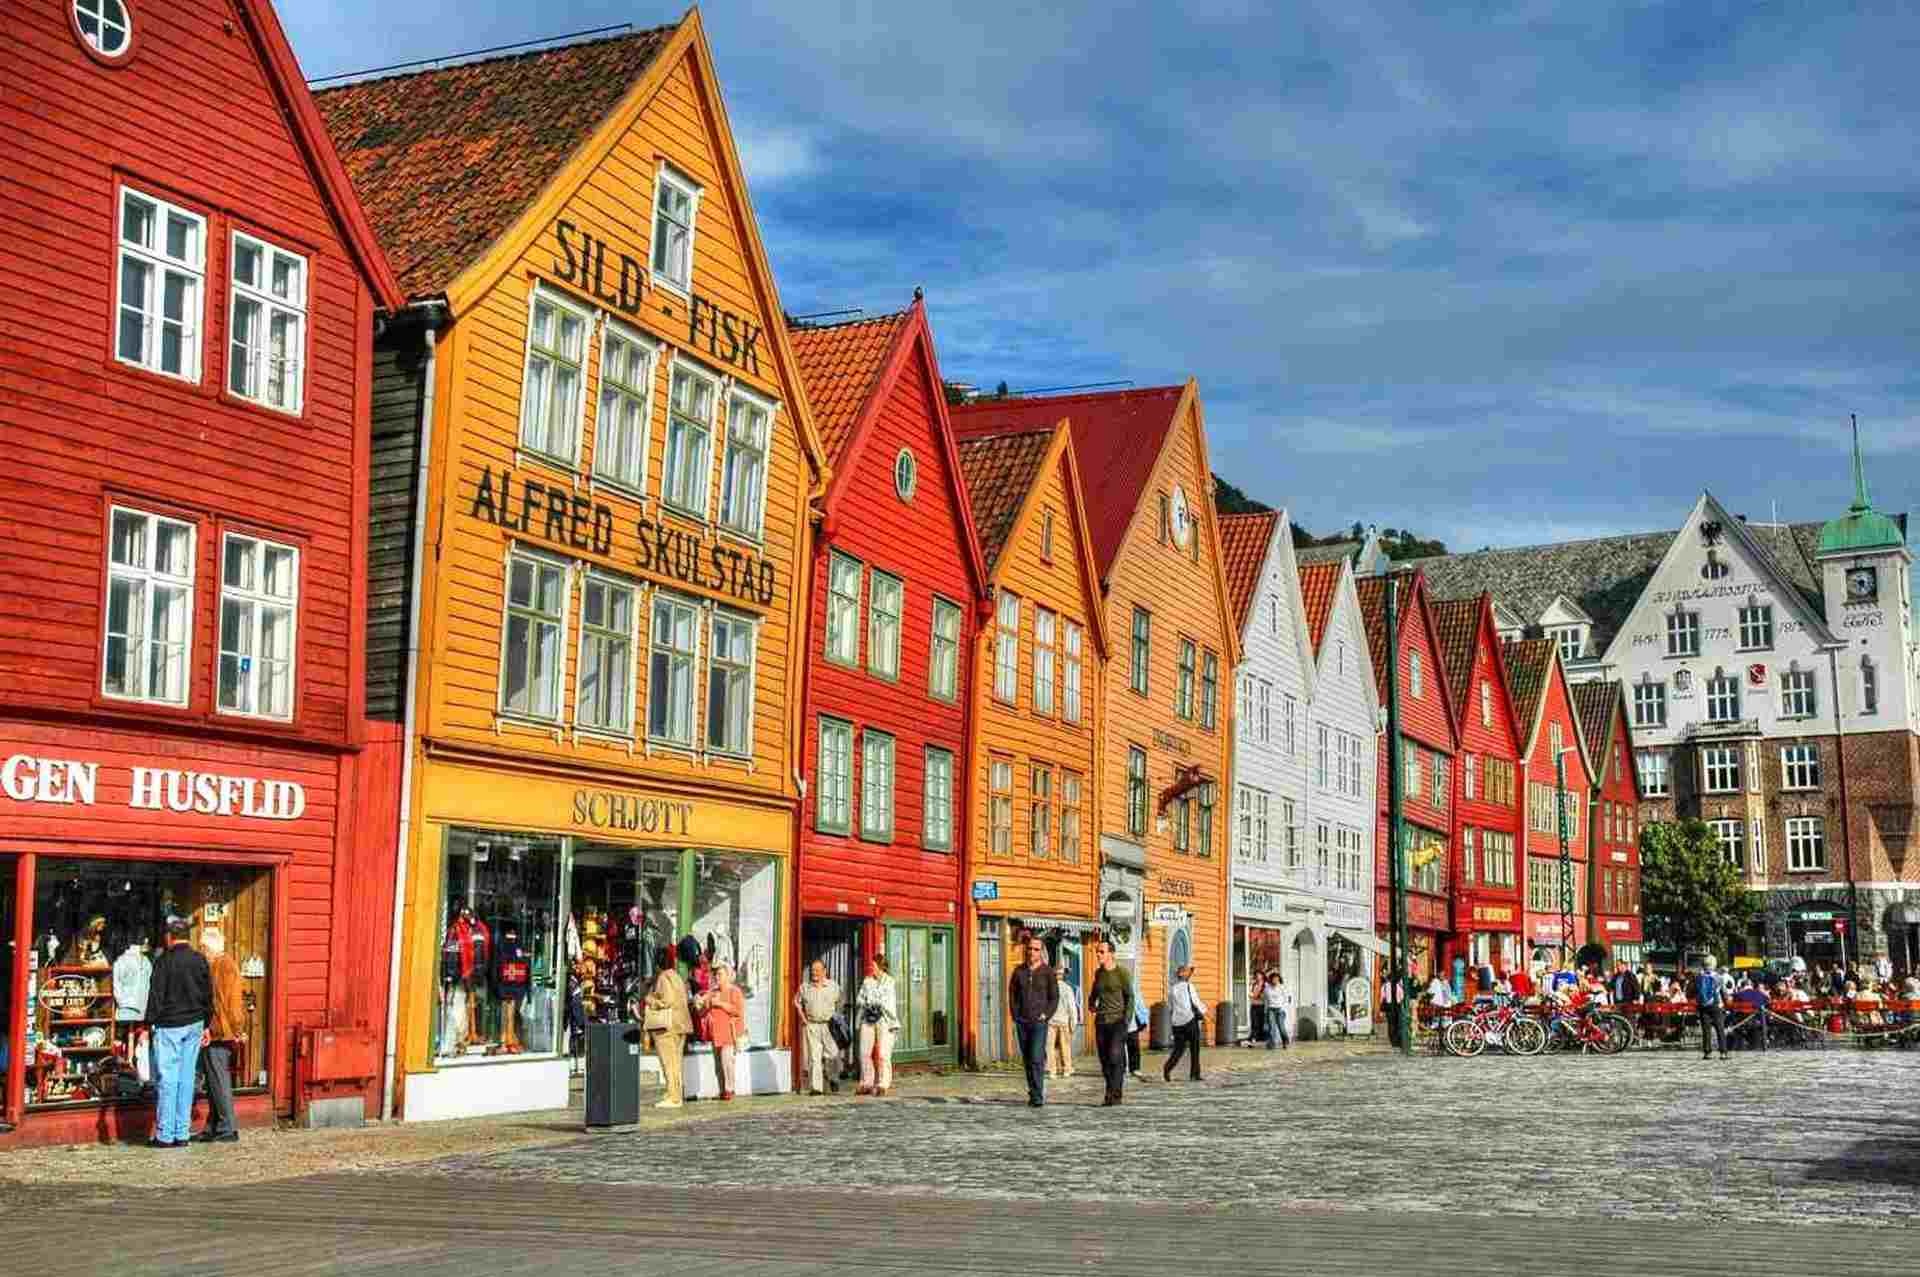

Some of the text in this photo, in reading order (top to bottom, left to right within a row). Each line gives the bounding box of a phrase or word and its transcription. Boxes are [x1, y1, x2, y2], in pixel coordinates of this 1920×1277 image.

[553, 218, 644, 315] SILD
[687, 294, 762, 377] FISK
[471, 465, 775, 606] ALFRED SKULSTAD
[0, 754, 306, 820] GEN HUSFLID
[571, 790, 693, 835] SCHJØTT
